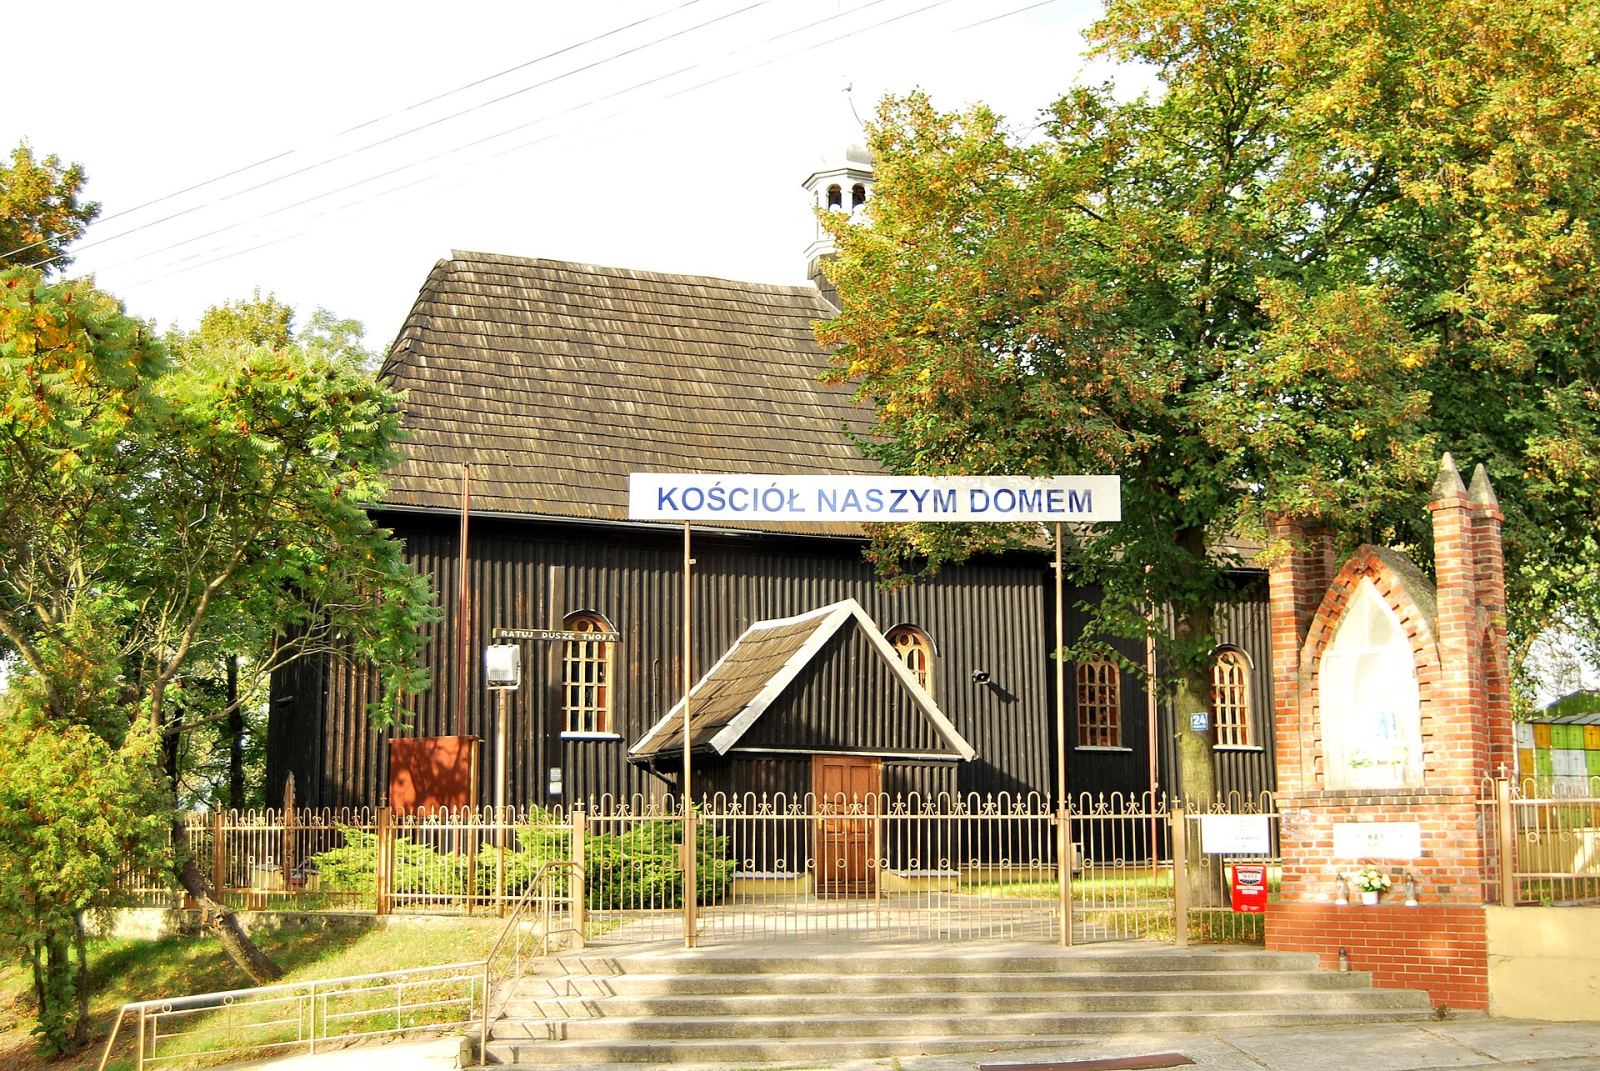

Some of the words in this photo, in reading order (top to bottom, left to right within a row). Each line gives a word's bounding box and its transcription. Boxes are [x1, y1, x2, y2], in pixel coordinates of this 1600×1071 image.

[658, 481, 805, 512] KOŚCIÓŁ
[817, 489, 957, 513] NASZYM
[970, 488, 1093, 513] DOMEM
[501, 630, 533, 638] RATUJ
[1192, 714, 1206, 725] 24
